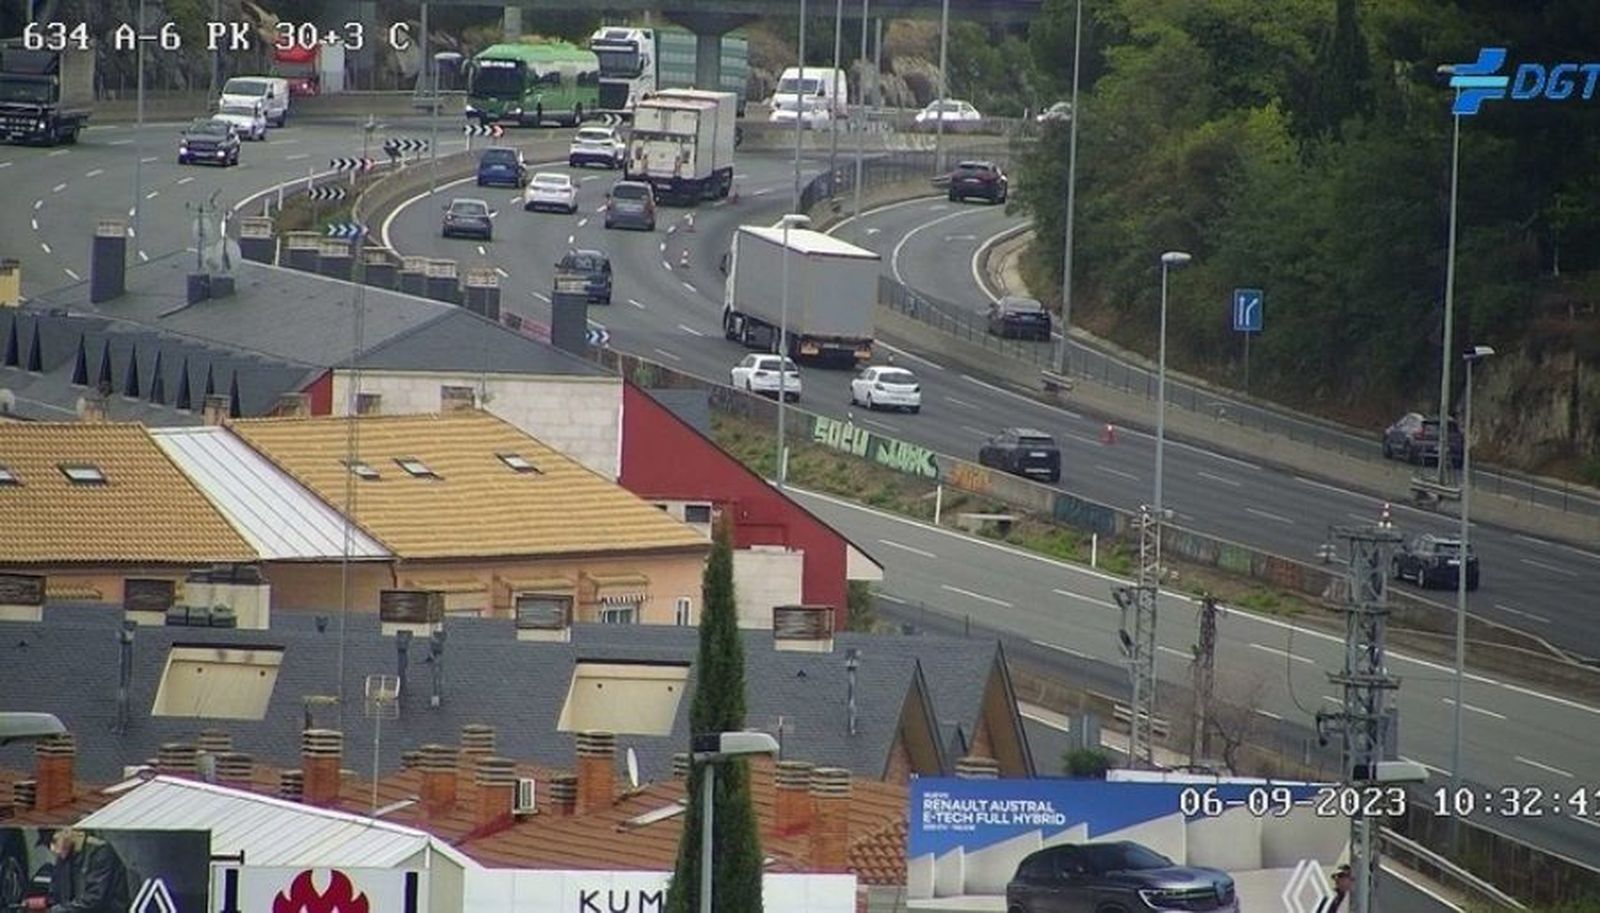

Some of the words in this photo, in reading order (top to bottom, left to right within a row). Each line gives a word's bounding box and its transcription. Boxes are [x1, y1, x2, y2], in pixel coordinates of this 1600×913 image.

[923, 800, 986, 812] RENAULT
[990, 801, 1055, 813] AUSTRAL
[923, 812, 975, 824] E-TECH
[976, 813, 1009, 825] FULL
[1013, 813, 1066, 825] HYBRID
